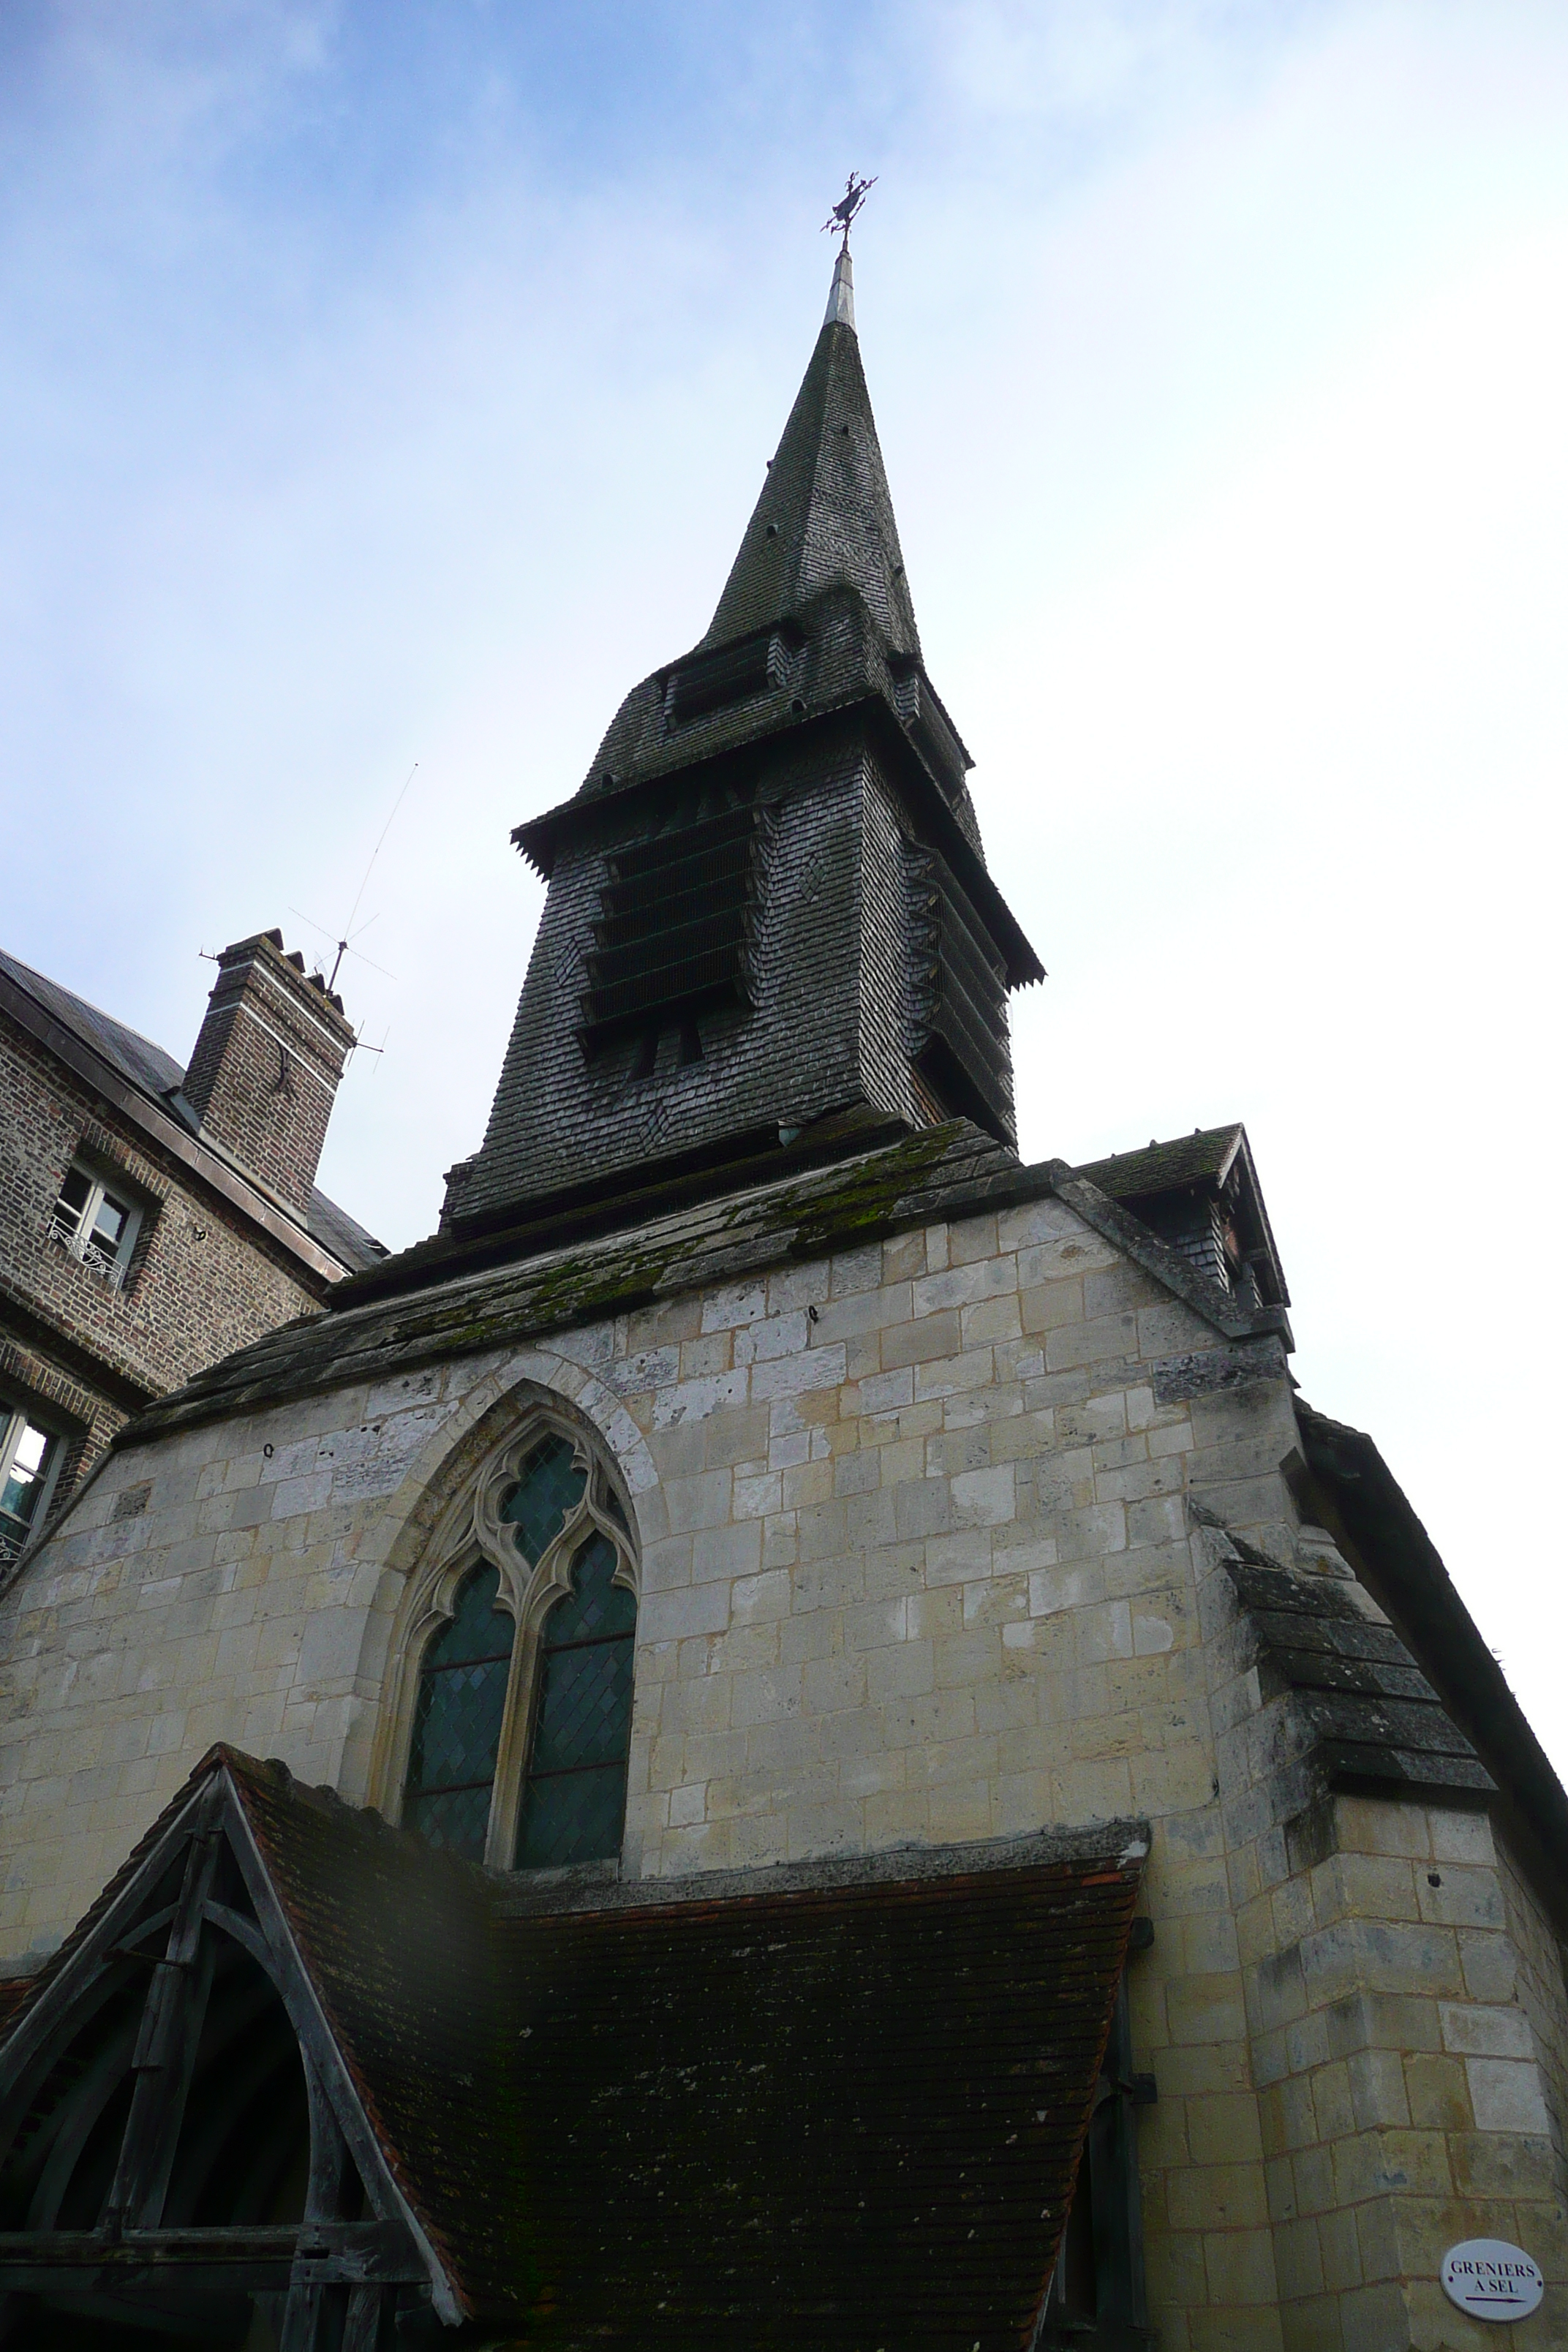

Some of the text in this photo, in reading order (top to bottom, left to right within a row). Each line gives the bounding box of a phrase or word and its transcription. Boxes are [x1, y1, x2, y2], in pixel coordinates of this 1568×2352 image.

[1450, 2261, 1535, 2277] GRENIERS
[1474, 2279, 1518, 2293] A SEL
